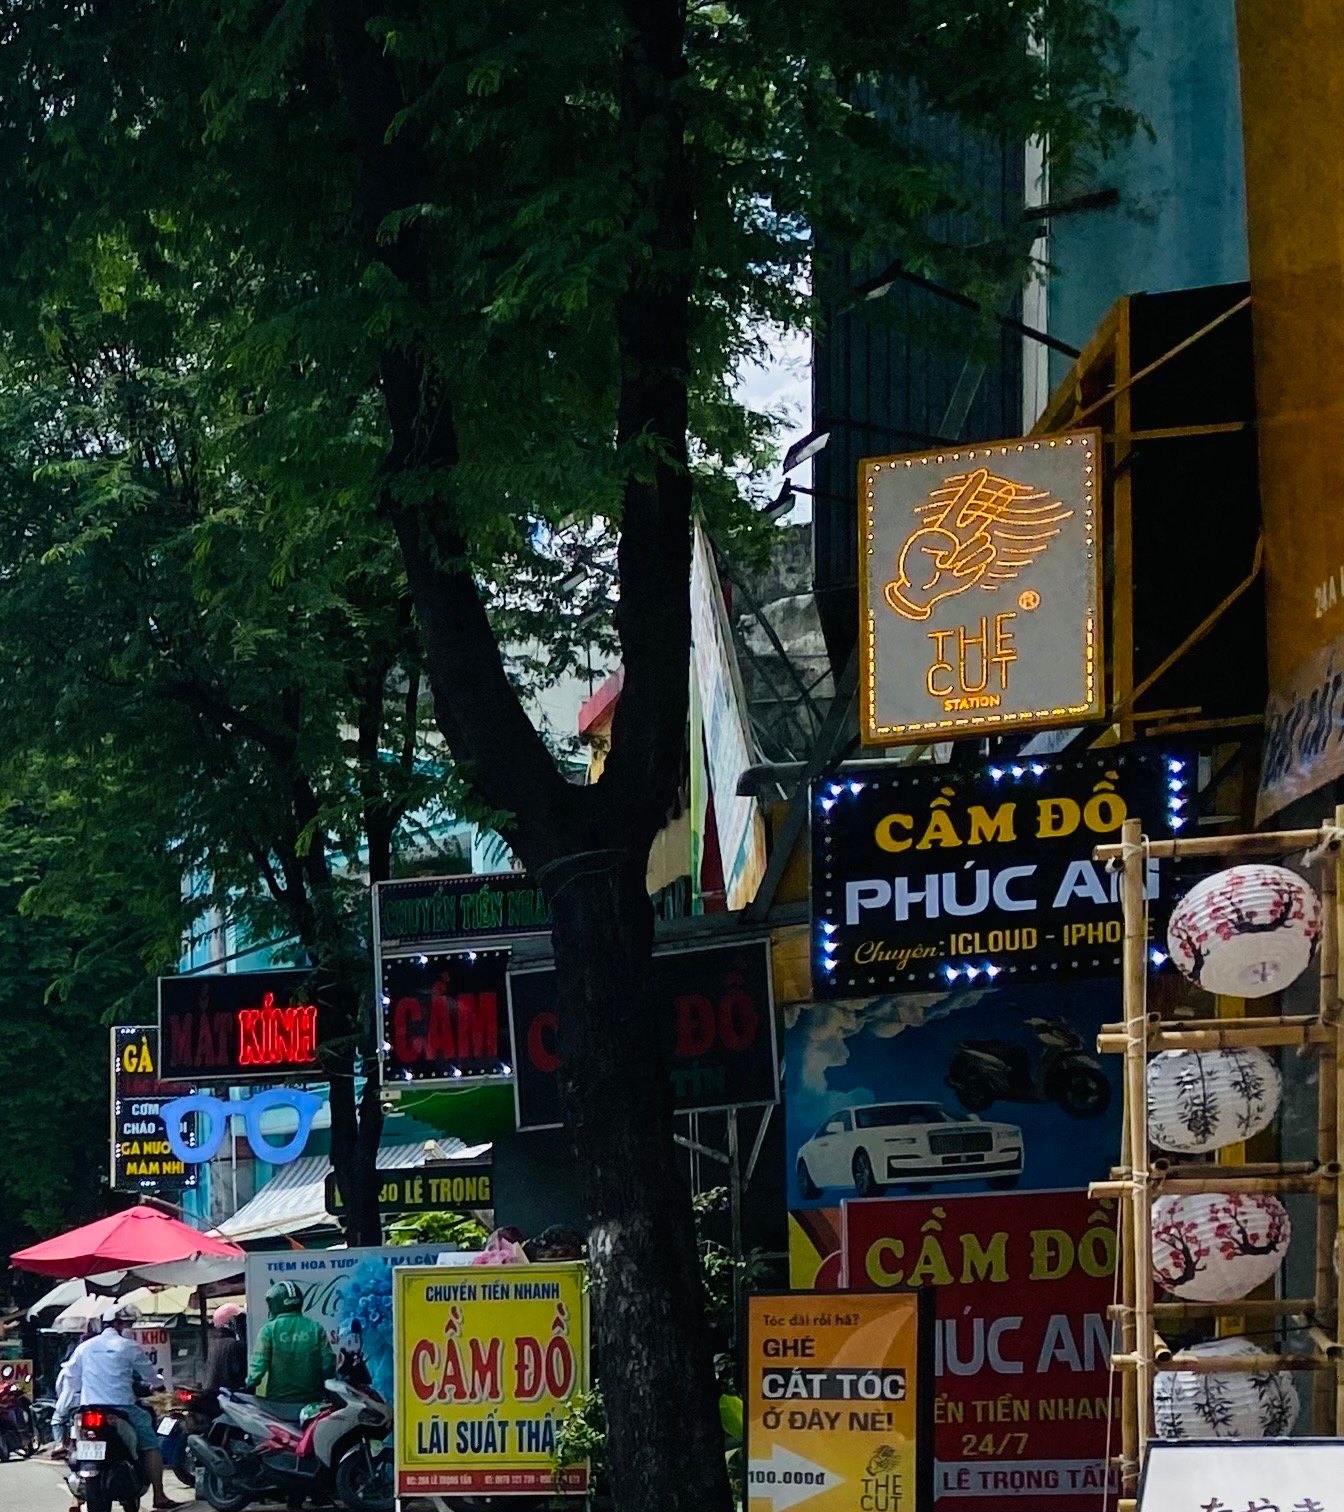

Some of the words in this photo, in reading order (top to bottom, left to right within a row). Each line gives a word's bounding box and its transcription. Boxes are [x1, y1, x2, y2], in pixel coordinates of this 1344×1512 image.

[927, 612, 1017, 663] THE
[926, 655, 1018, 696] CUT
[943, 694, 1001, 712] STATION
[875, 786, 1017, 853] CẦM
[1035, 770, 1128, 839] ĐỒ
[506, 888, 552, 927] NHA
[845, 860, 1038, 926] PHÚC
[950, 927, 1038, 956] ICLOUD
[1063, 917, 1155, 946] IPHO
[123, 1034, 154, 1073] GÀ
[131, 1103, 160, 1116] CƠM
[123, 1121, 156, 1135] CHÁO
[404, 1175, 424, 1204] LÊ
[428, 1176, 491, 1207] TRỌNG
[865, 1206, 1010, 1288] CẦM
[1028, 1199, 1122, 1281] ĐỒ
[266, 1260, 297, 1273] TIỆM
[300, 1260, 326, 1270] HOA
[425, 1279, 477, 1302] CHUYỂN
[480, 1280, 510, 1301] TIỀN
[514, 1282, 560, 1301] NHANH
[763, 1314, 785, 1327] Tóc
[279, 1329, 311, 1343] Gab
[762, 1336, 816, 1358] GHÉ
[934, 1305, 1024, 1377] ÚC
[411, 1305, 502, 1401] CẦM
[514, 1302, 573, 1400] ĐỒ
[762, 1367, 828, 1399] CẮT
[836, 1370, 906, 1400] TÓC
[762, 1406, 784, 1431] Ở
[788, 1406, 843, 1431] ĐÂY
[848, 1409, 894, 1432] NÈ!
[971, 1393, 1030, 1423] TIỀN
[417, 1415, 449, 1455] LÃI
[456, 1408, 510, 1454] SUẤT
[961, 1432, 1030, 1456] 24/7
[748, 1470, 826, 1486] 100.000đ
[860, 1475, 904, 1496] THE
[943, 1467, 971, 1491] LÊ
[977, 1469, 1060, 1495] TRỌNG
[860, 1495, 903, 1512] CUT
